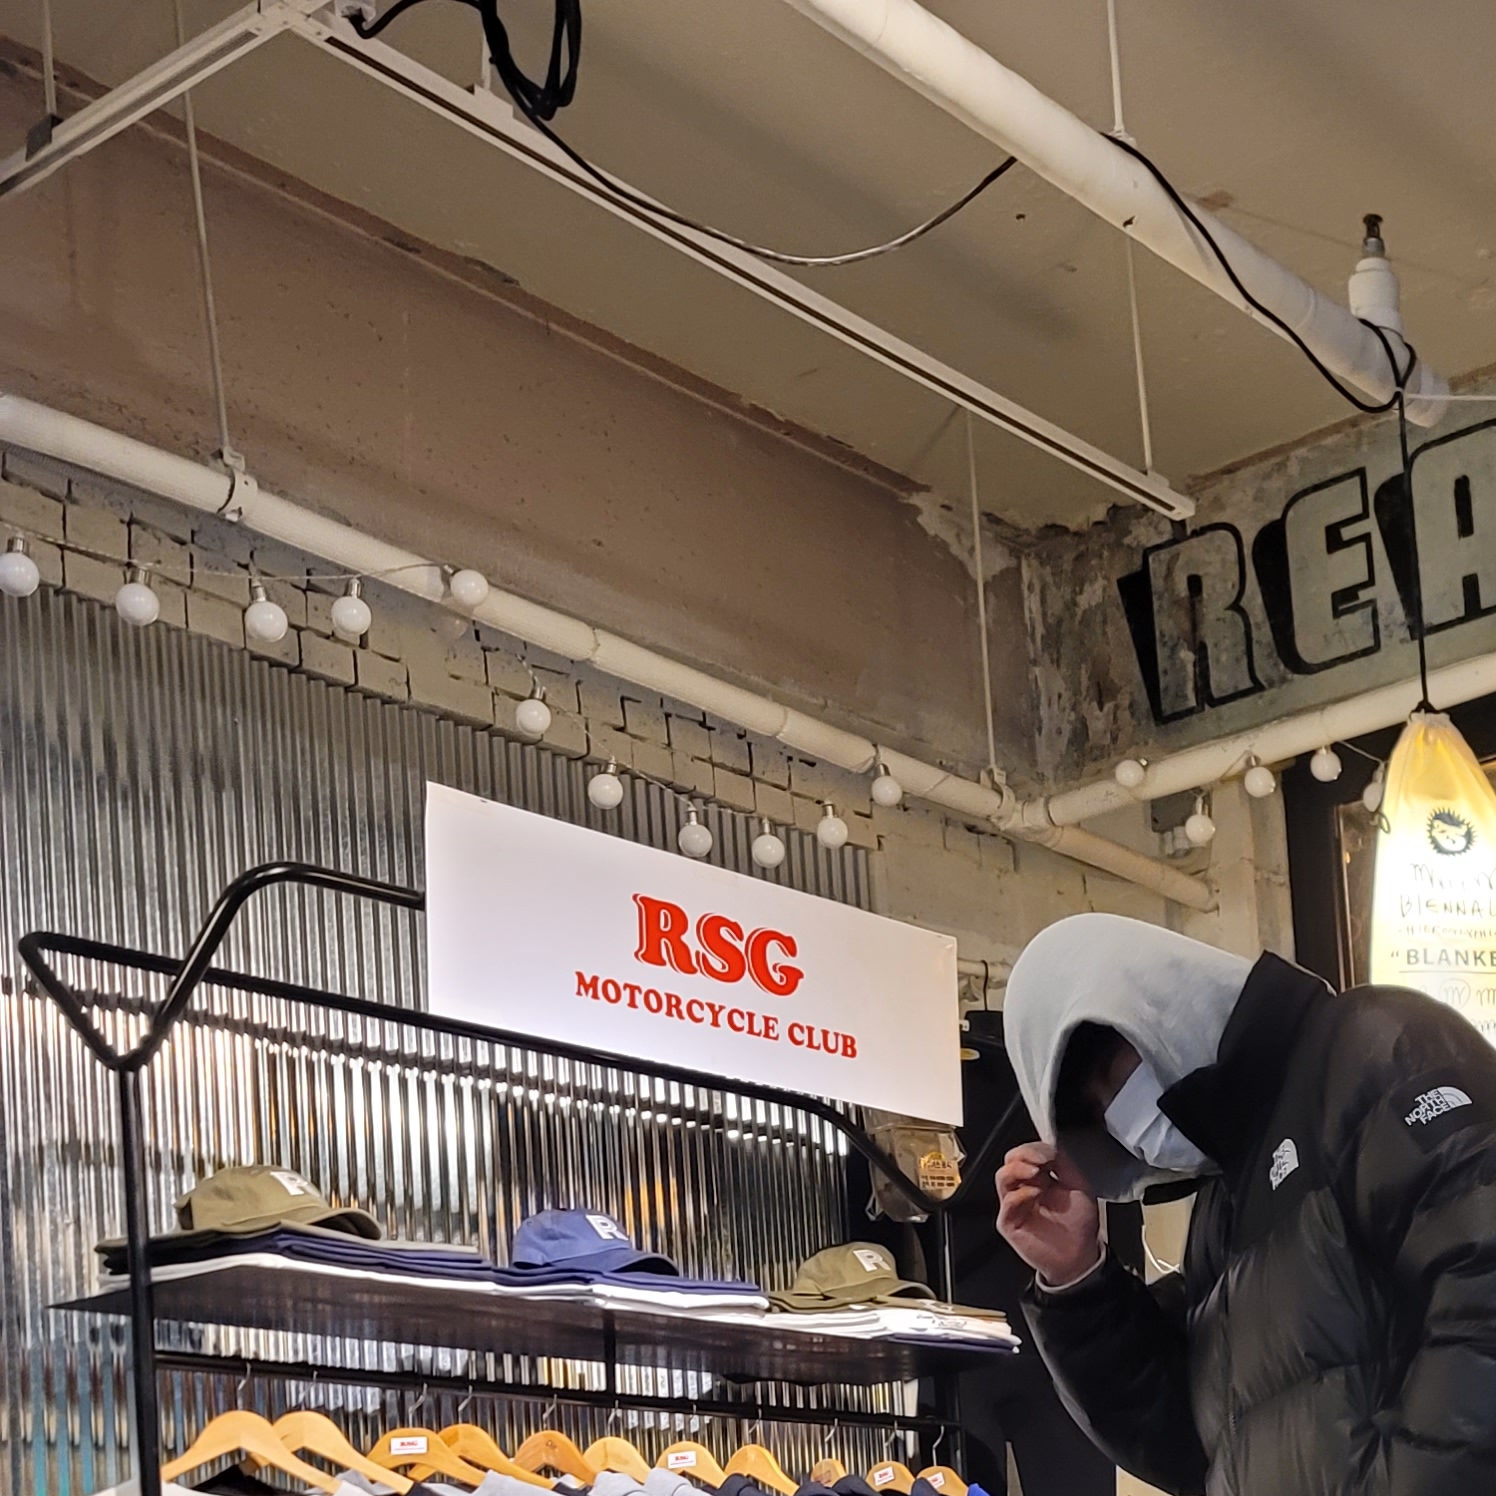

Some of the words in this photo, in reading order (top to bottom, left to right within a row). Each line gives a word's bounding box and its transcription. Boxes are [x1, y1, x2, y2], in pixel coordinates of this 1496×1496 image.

[631, 892, 805, 997] RSG
[574, 970, 780, 1042] MOTORCYCLE
[787, 1019, 858, 1060] CLUB
[1404, 1095, 1446, 1126] NORTH
[1419, 1103, 1452, 1126] FACE
[585, 1213, 630, 1242] R
[852, 1248, 892, 1273] R
